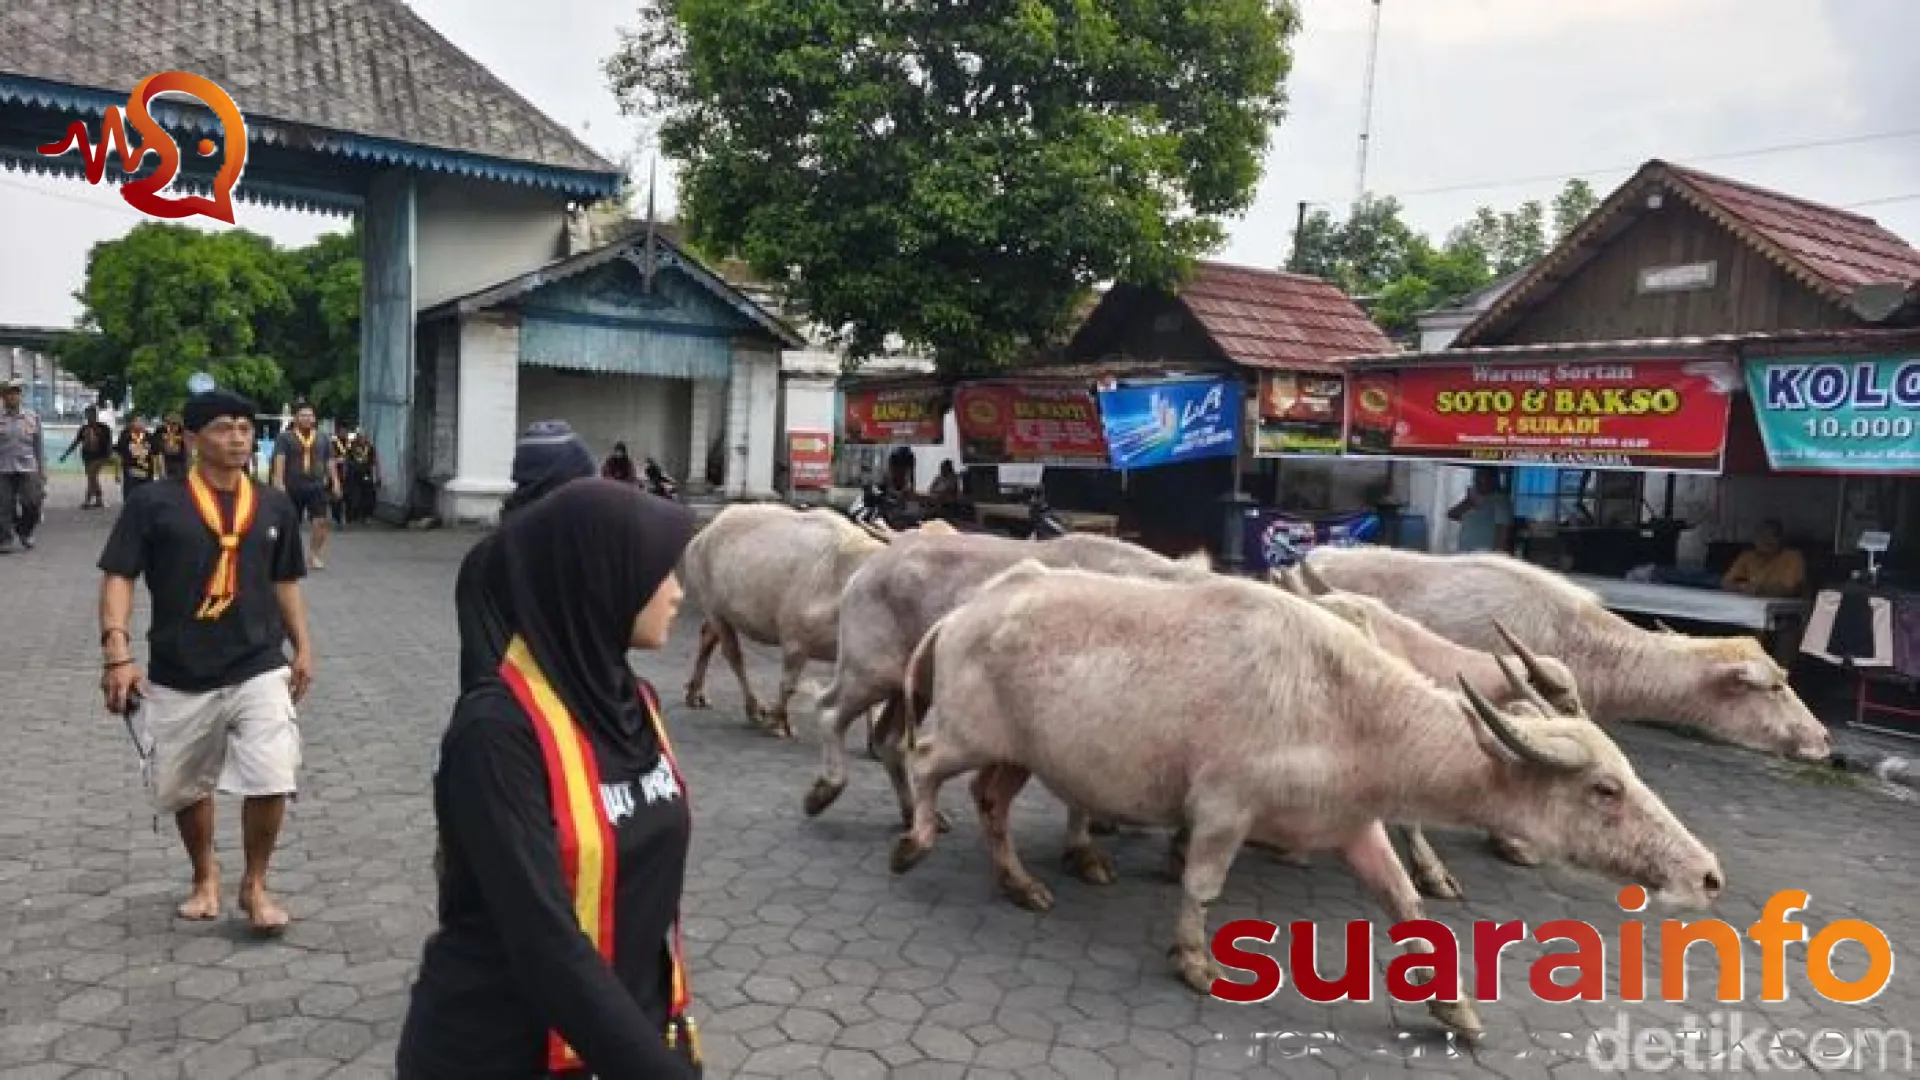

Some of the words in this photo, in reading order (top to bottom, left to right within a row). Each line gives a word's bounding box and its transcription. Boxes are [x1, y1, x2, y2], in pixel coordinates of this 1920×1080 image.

[1472, 362, 1551, 384] Warung
[1437, 390, 1515, 412] SOTO
[1521, 389, 1548, 412] &
[1555, 389, 1680, 415] BAKSO
[1496, 416, 1512, 433] P.
[1516, 416, 1600, 434] SURADI
[1803, 416, 1913, 438] 10.000
